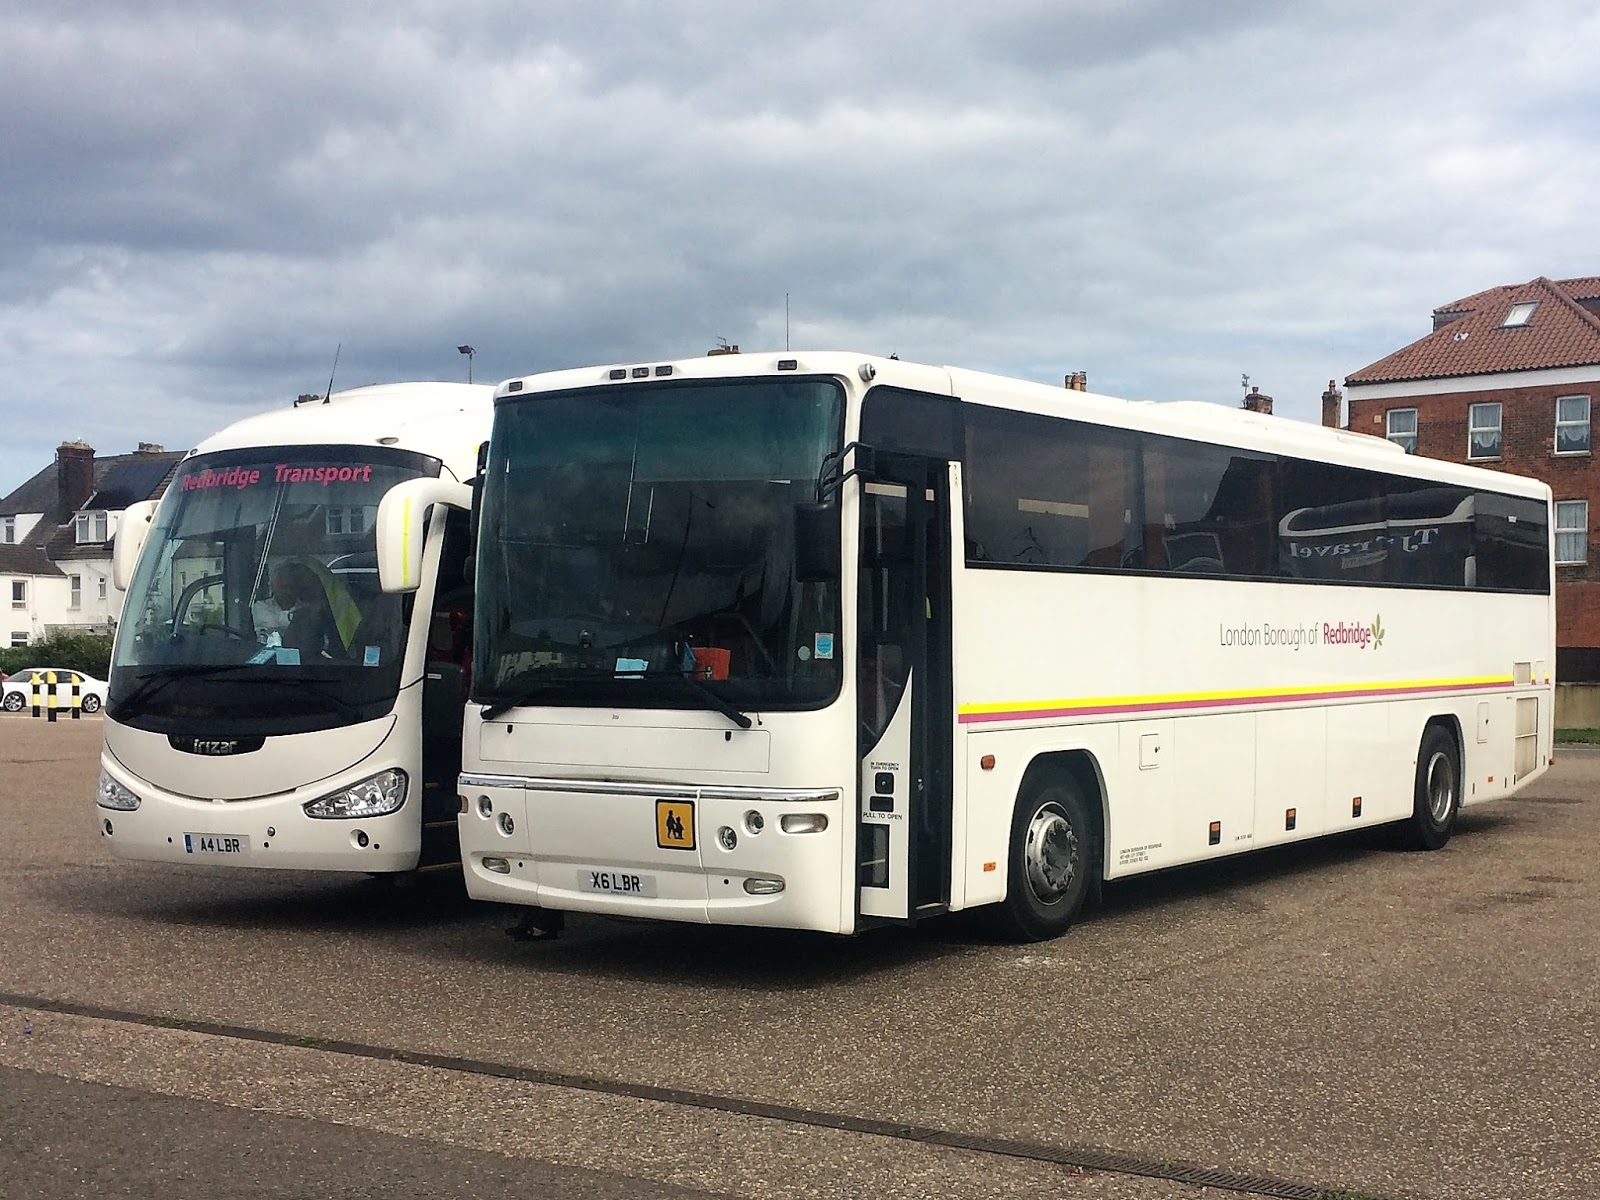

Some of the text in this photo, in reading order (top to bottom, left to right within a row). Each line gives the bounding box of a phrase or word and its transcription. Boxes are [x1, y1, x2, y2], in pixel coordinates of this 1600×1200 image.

[181, 463, 372, 491] Redbridge Transport
[1219, 621, 1371, 651] London Borough of Redbridge
[863, 811, 876, 819] PULL
[201, 837, 241, 853] A4 LBR
[591, 871, 641, 892] X6 LBR
